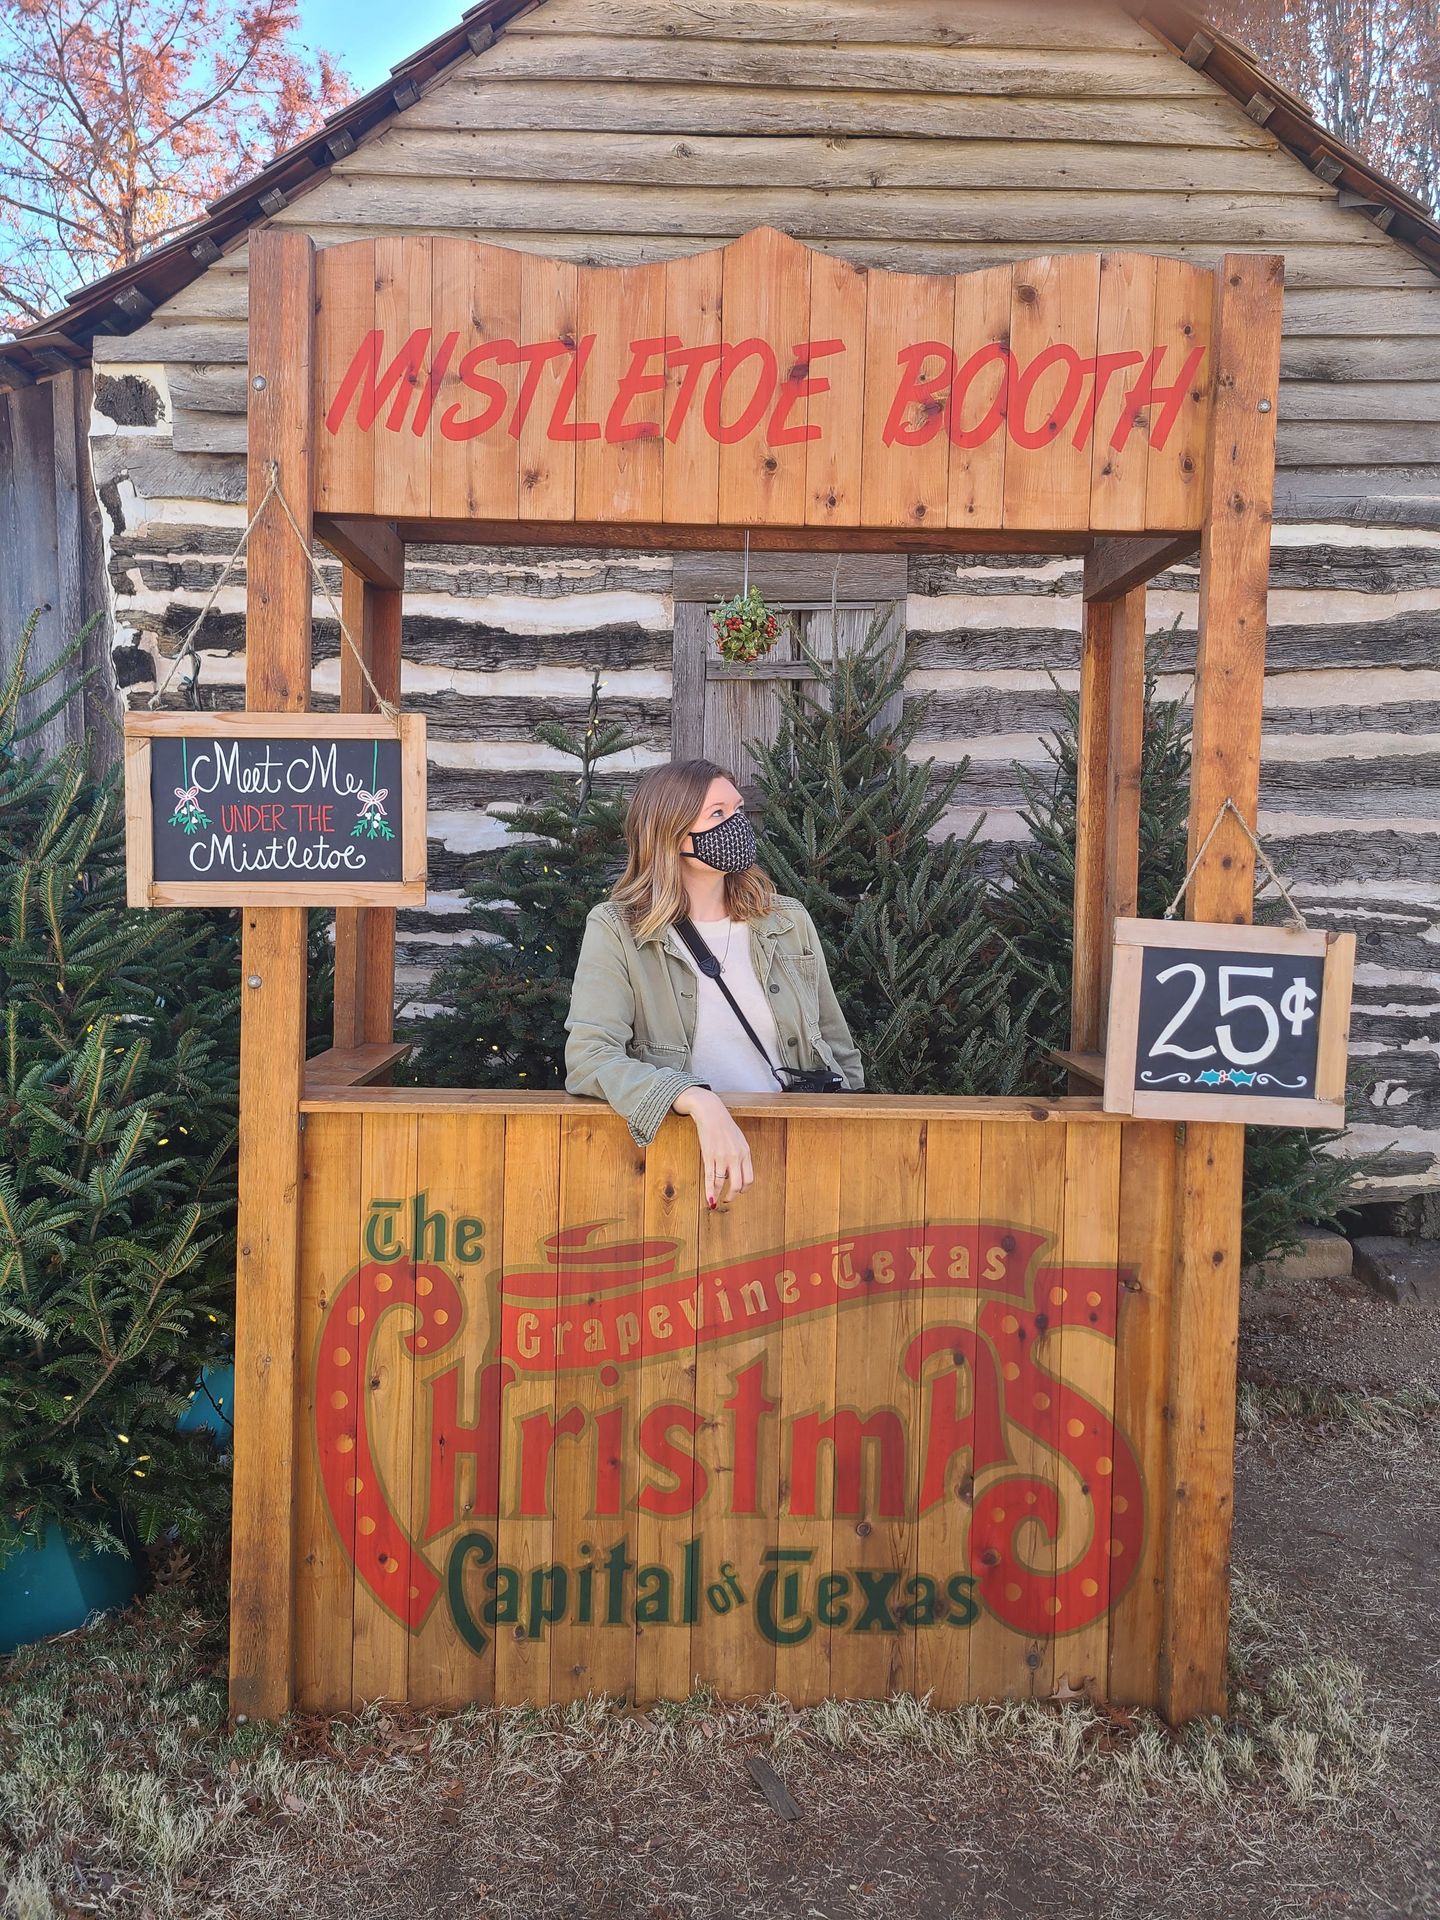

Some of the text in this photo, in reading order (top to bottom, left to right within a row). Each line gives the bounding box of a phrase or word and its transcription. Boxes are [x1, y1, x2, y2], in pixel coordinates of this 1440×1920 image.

[325, 328, 1207, 453] MISTLETOE BOOTH
[191, 741, 363, 796] Meet Me
[188, 833, 367, 873] Mistletoe
[220, 804, 336, 833] UNDER THE
[1148, 962, 1318, 1066] 25¢
[364, 1189, 486, 1265] The
[516, 1242, 1010, 1359] Grapevine Texas
[444, 1531, 984, 1659] Capital of Texas
